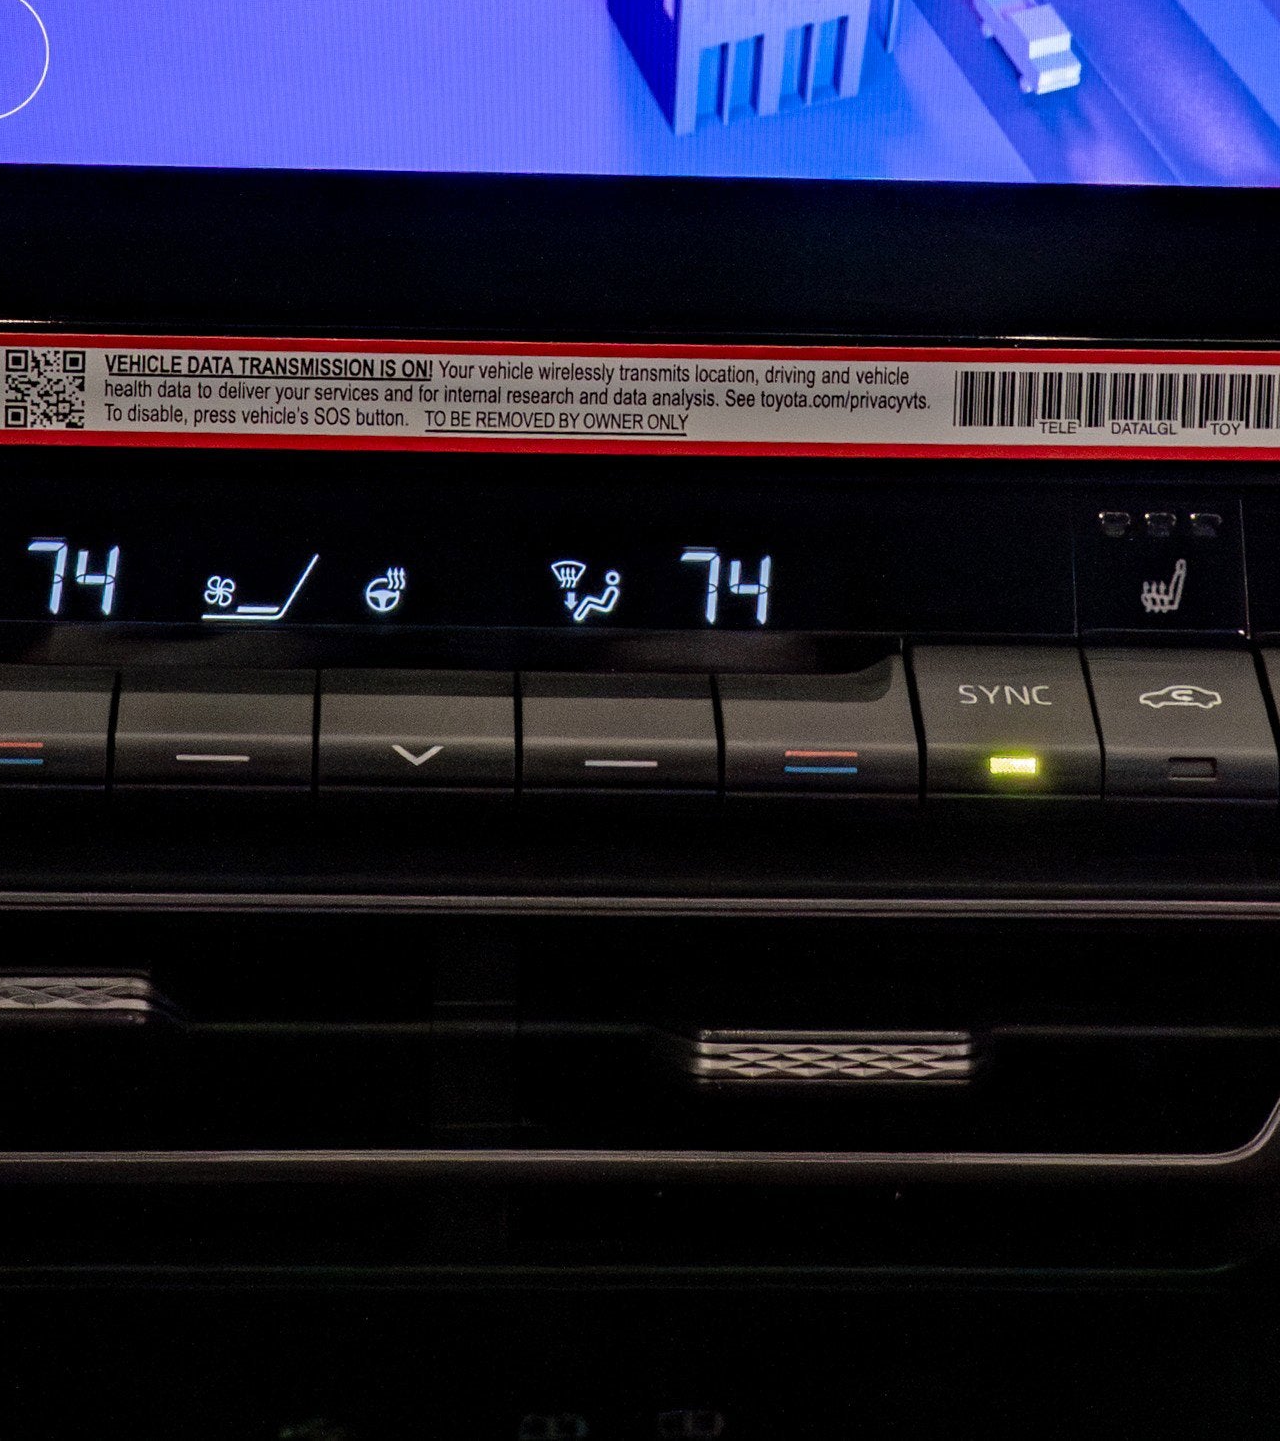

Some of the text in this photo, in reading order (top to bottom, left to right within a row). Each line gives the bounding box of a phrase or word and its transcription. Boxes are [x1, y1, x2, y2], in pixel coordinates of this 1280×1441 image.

[104, 354, 910, 389] VEHICLE DATA TRANSMISSION IS ON! Your vehicle wirelessly transmits location, driving and vehicle
[104, 379, 932, 413] health data to deliver your services and for internal research and data analysis. See toyota.com/privacyvts.
[104, 402, 689, 431] To disable, press vehicle's SOS button. TO BE REMOVED BY OWNER ONLY
[1039, 421, 1241, 436] TELE DATALGL TOY
[27, 541, 120, 616] 74
[680, 551, 772, 625] 74
[958, 684, 1053, 706] SYNC
